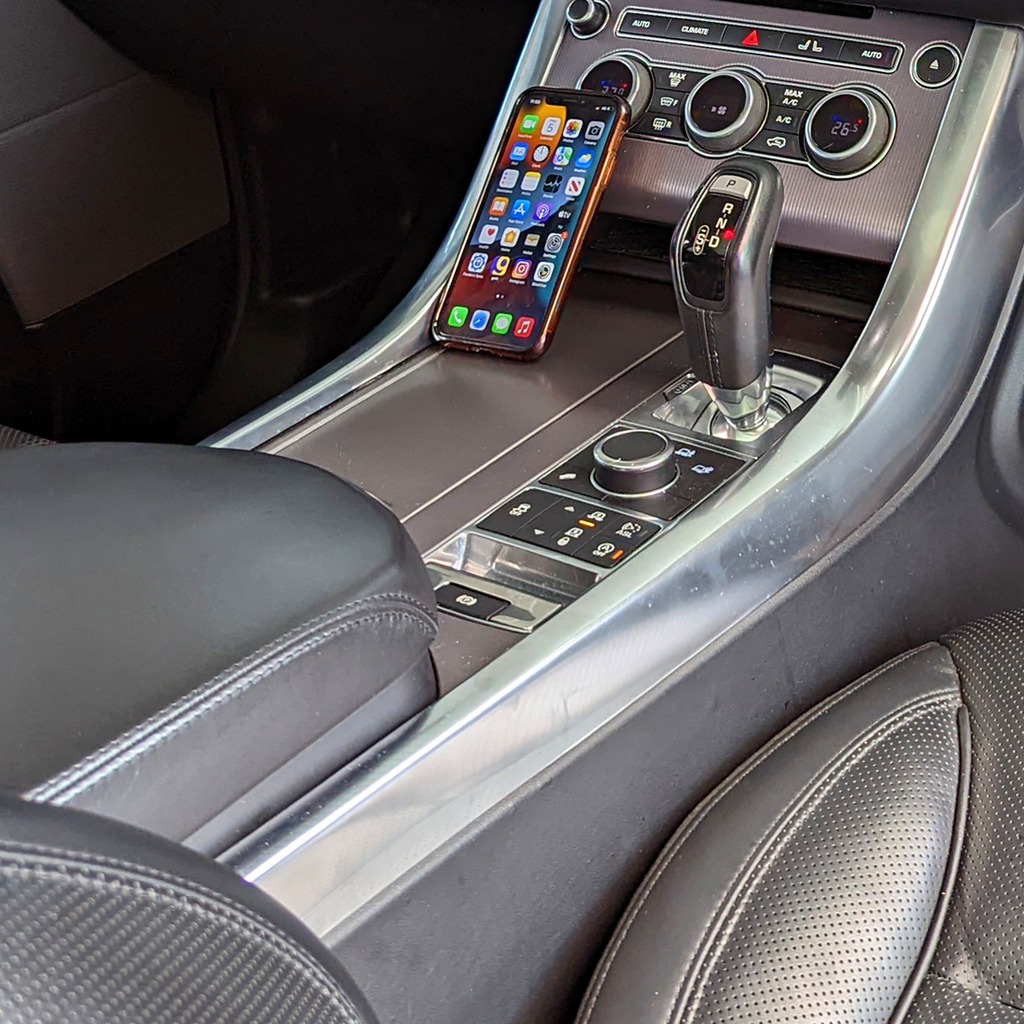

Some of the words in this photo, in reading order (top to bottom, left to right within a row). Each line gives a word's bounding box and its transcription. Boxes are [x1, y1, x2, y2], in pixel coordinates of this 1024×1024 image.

[631, 19, 651, 29] AUTO
[681, 25, 709, 36] CLIMATE
[861, 50, 882, 59] AUTO
[668, 71, 687, 81] MAX
[784, 88, 804, 98] MAX
[782, 98, 799, 106] A/C
[775, 115, 792, 124] A/C
[666, 121, 672, 129] R
[830, 121, 859, 136] 26.5
[726, 179, 737, 188] P
[722, 202, 734, 215] R
[715, 217, 728, 230] N
[708, 235, 720, 248] D
